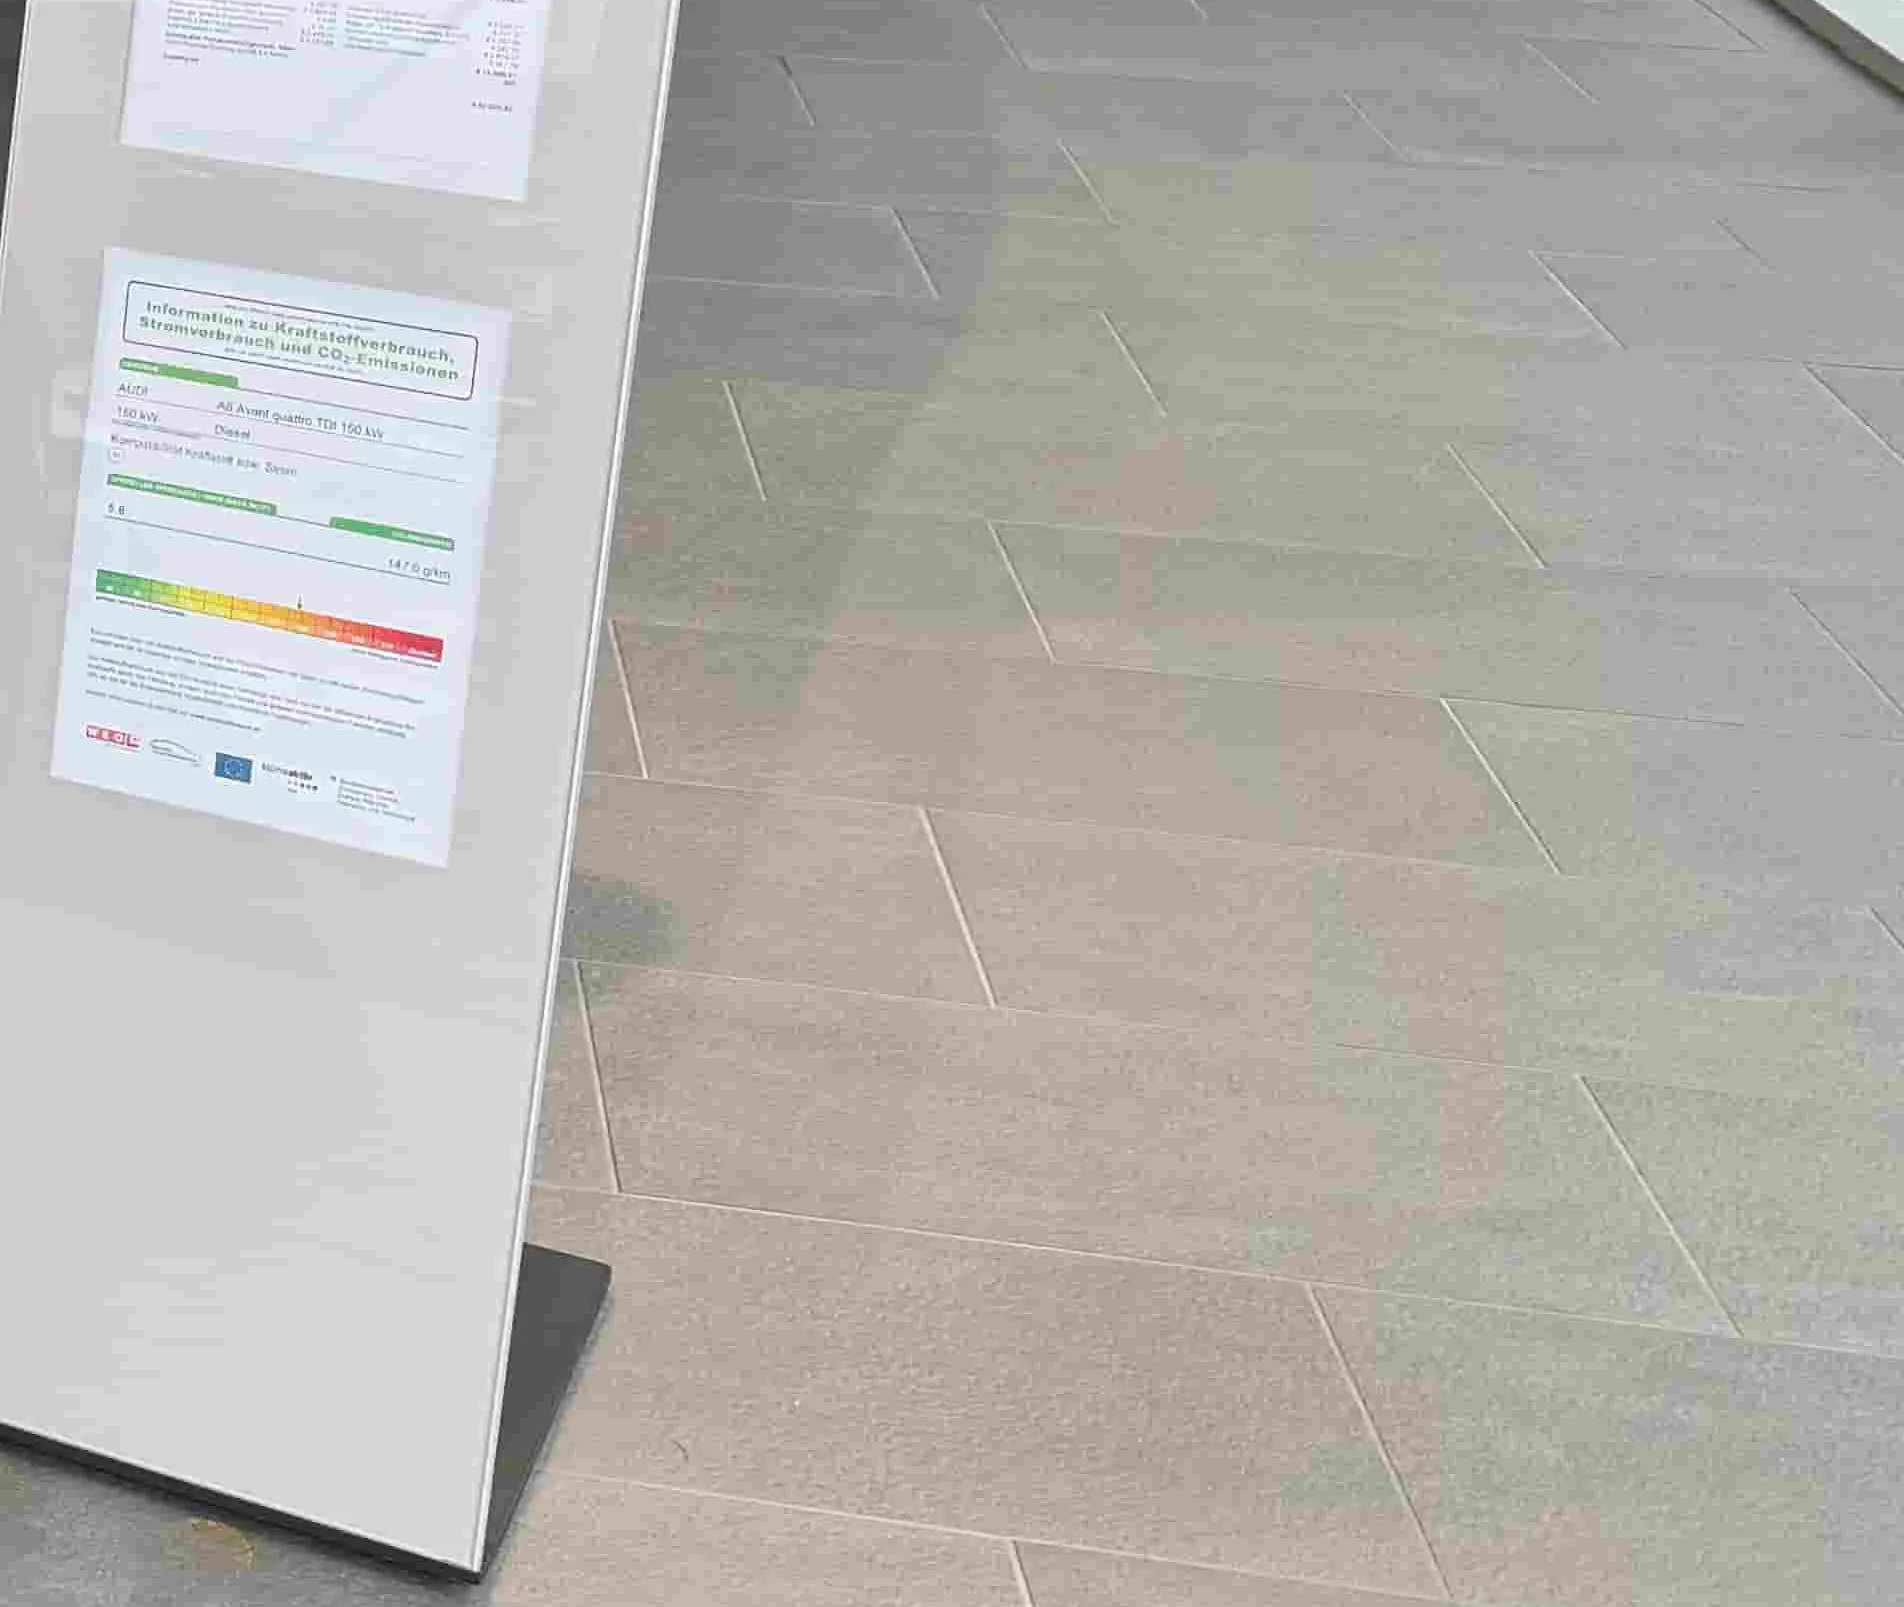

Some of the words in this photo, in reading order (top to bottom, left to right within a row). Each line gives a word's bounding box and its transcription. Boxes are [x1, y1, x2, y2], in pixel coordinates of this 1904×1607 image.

[139, 315, 274, 349] Stromverbrauch
[281, 339, 311, 356] und
[145, 299, 243, 328] Information
[249, 318, 269, 332] zu
[275, 321, 455, 364] Kraftstoffverbrauch,
